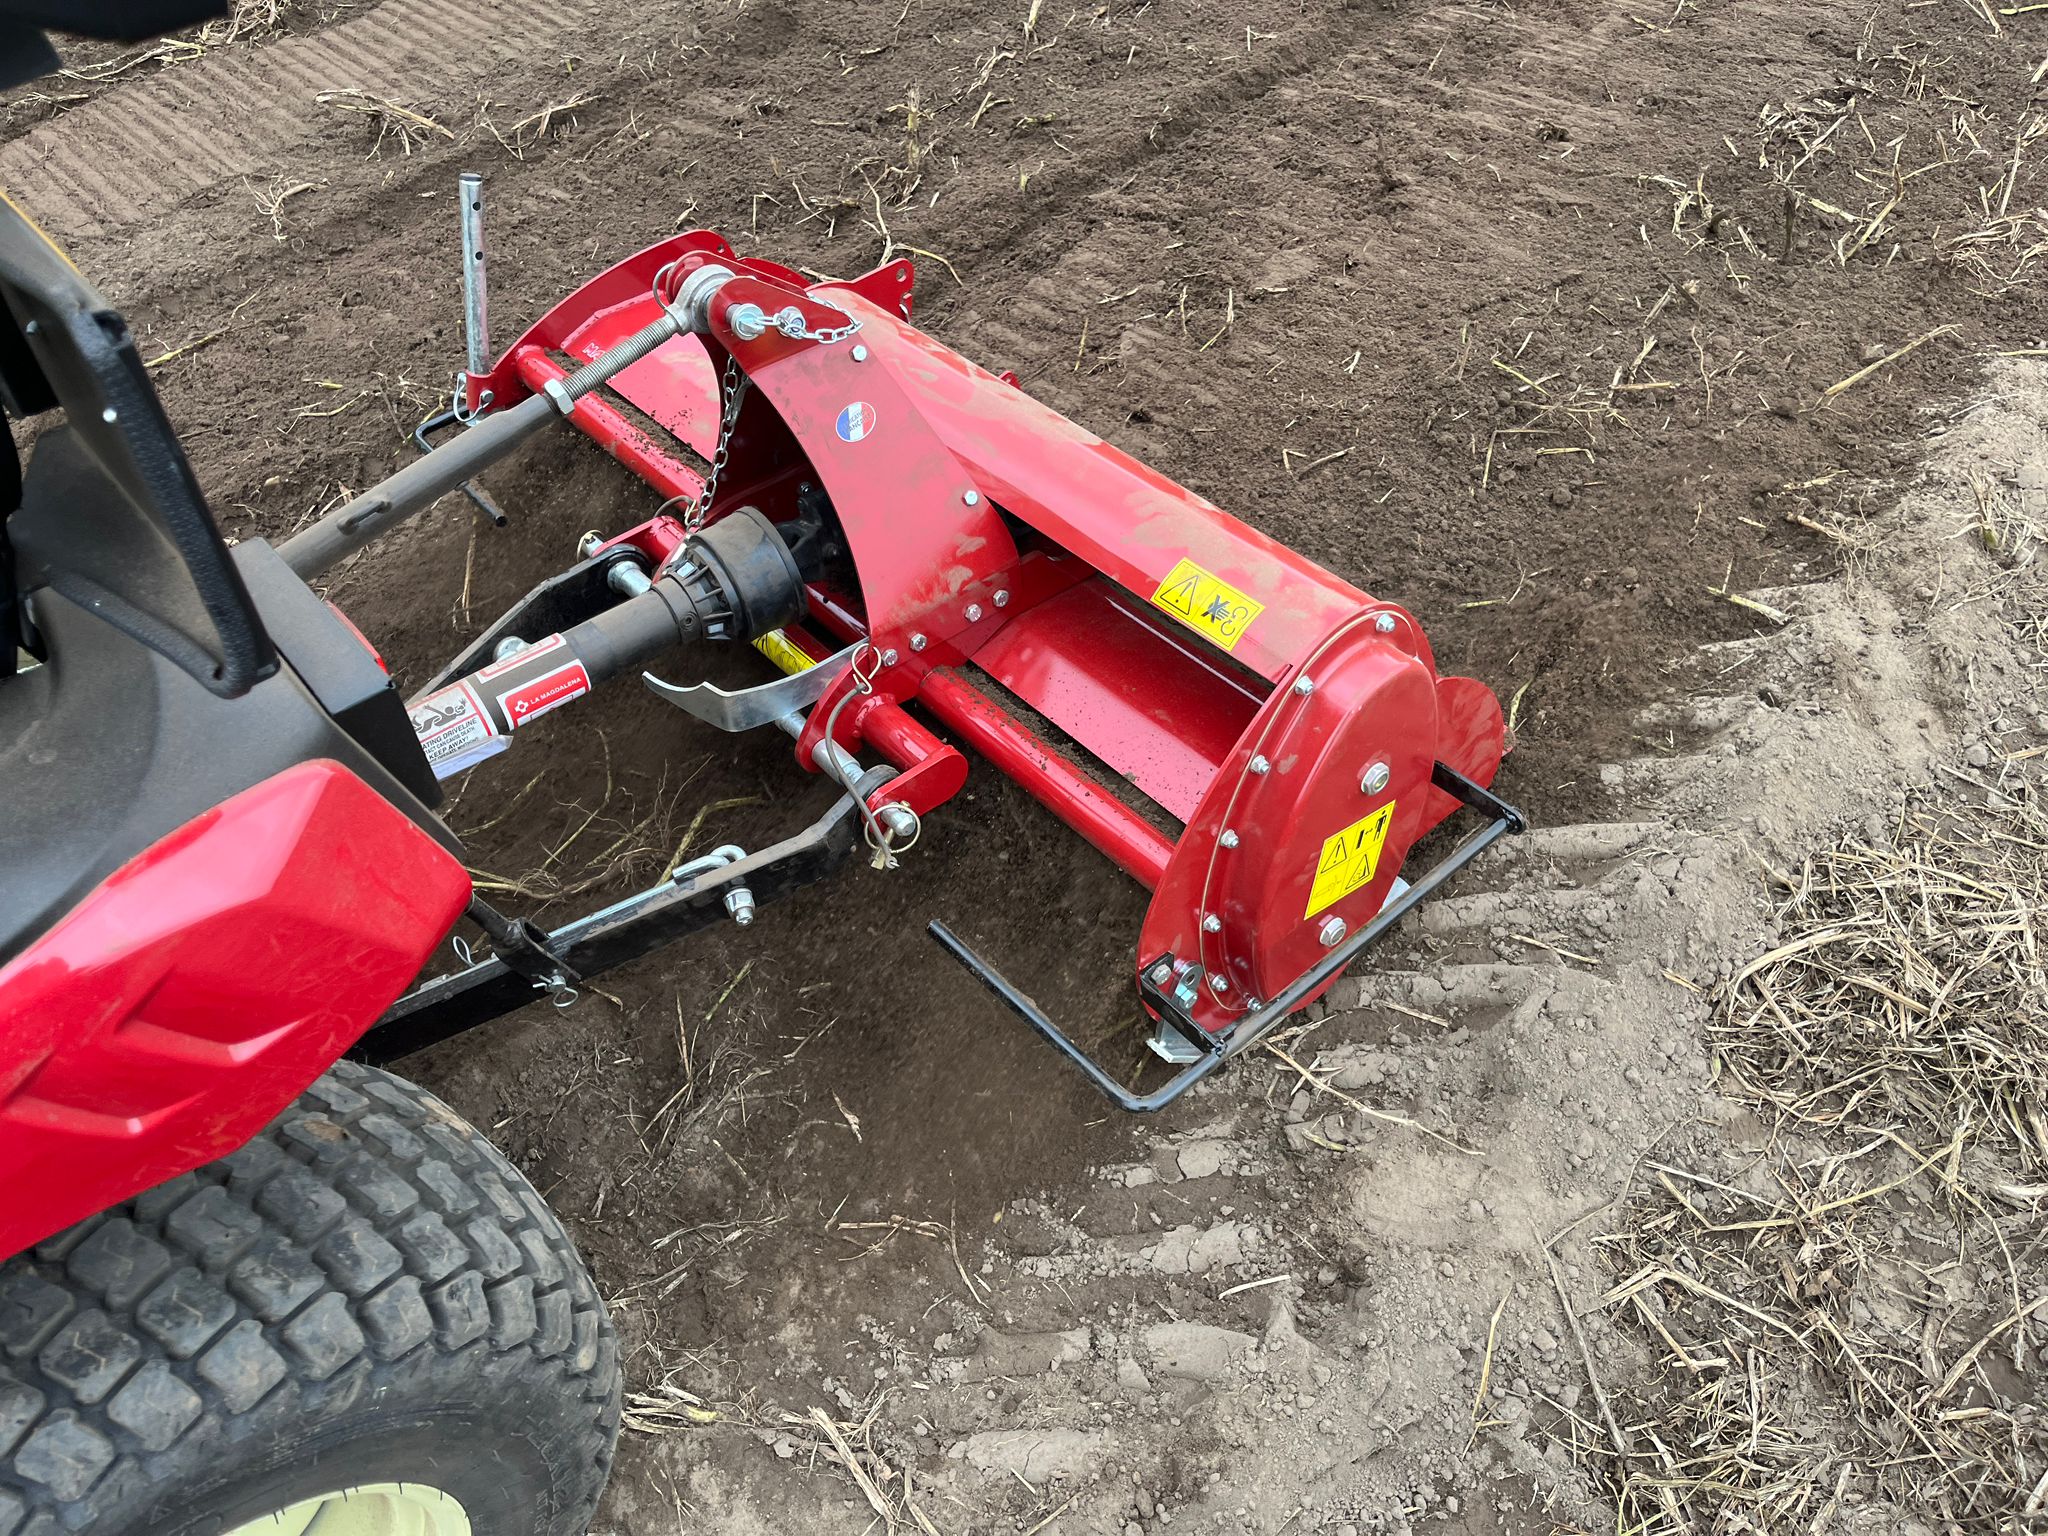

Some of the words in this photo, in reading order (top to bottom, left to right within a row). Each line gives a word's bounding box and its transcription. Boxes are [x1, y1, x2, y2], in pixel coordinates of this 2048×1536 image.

[540, 677, 582, 700] MAGDALENA
[421, 736, 442, 749] ATING
[442, 717, 477, 740] DRIVELINE
[428, 747, 448, 760] KEEP
